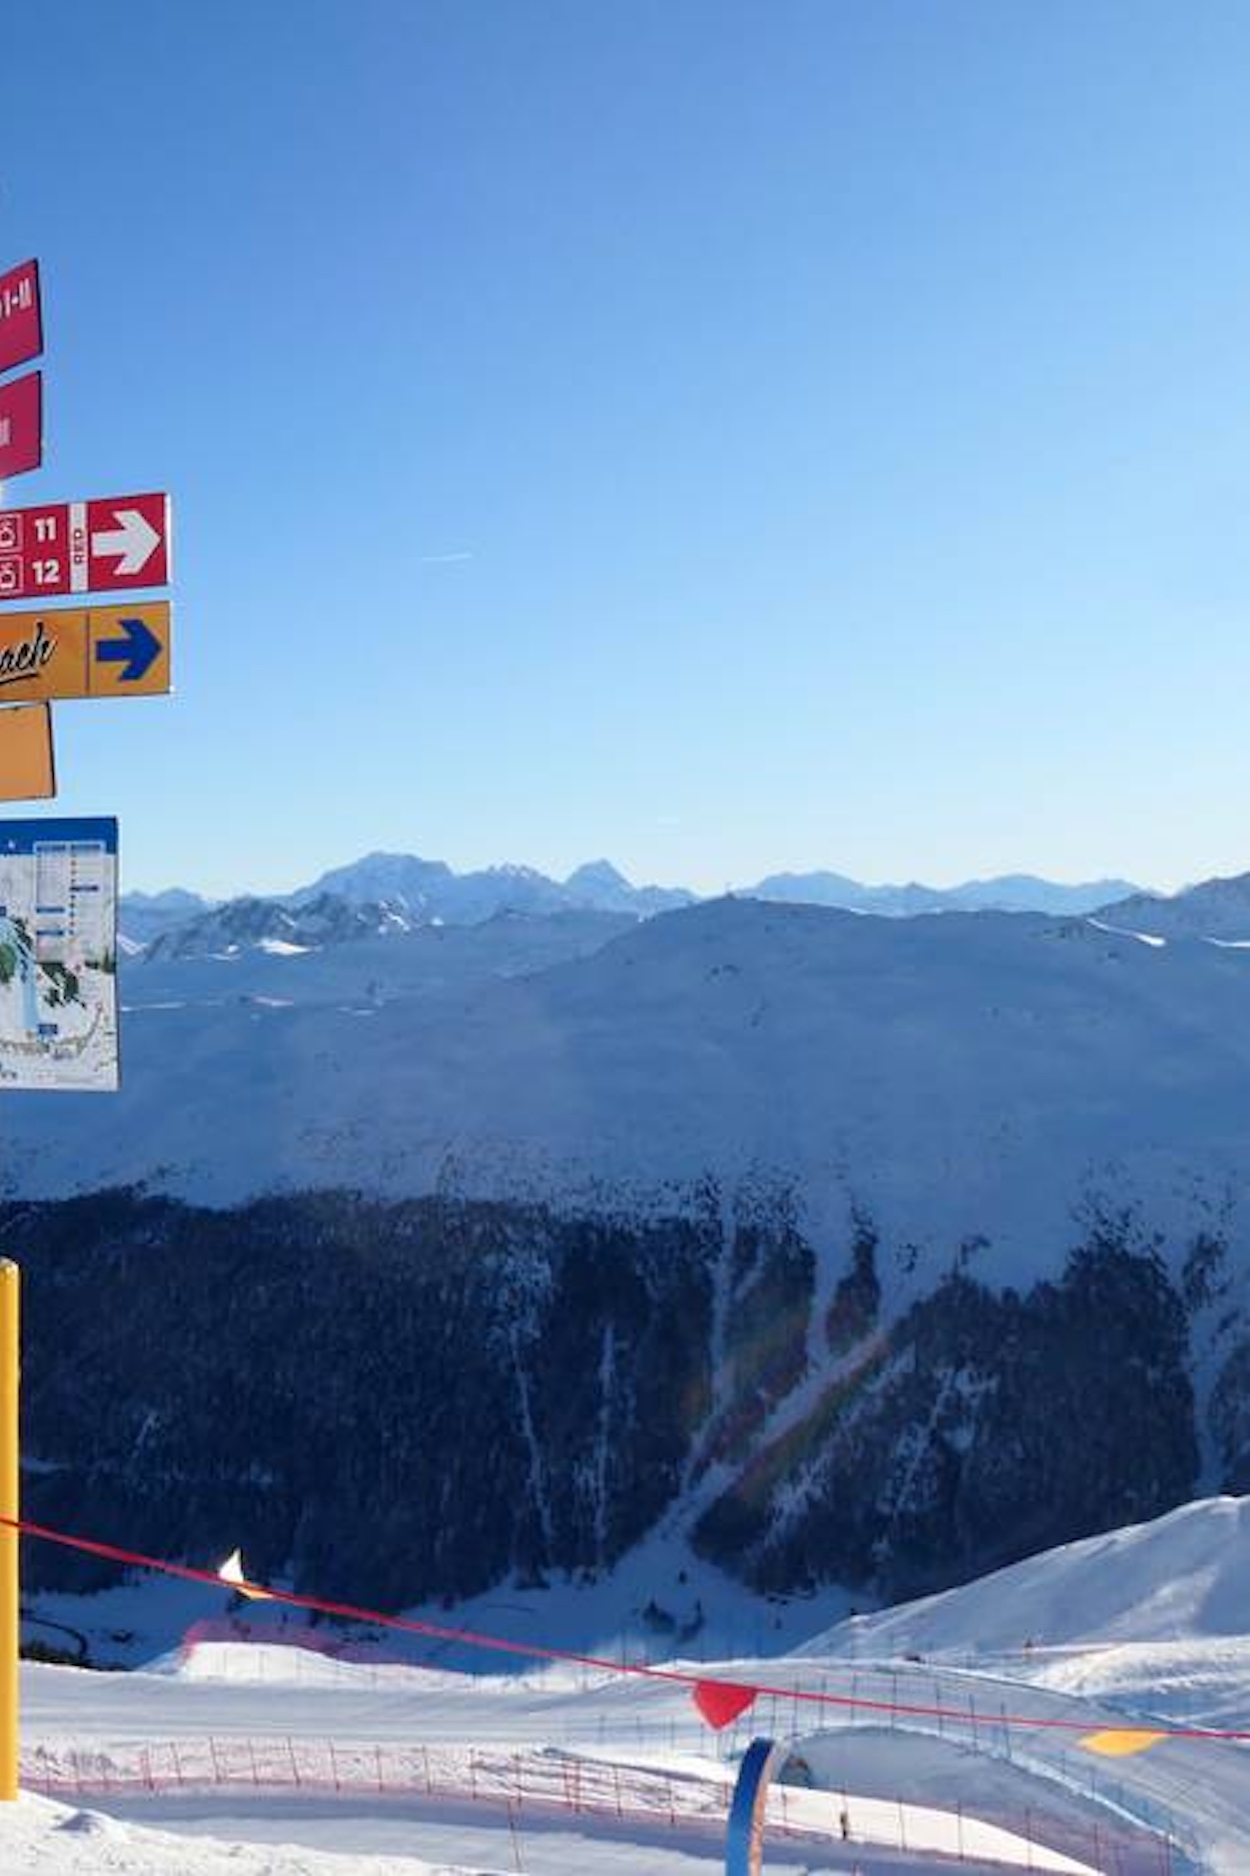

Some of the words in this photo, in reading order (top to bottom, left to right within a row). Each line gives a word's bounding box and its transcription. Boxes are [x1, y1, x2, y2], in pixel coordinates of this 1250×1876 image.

[4, 277, 32, 318] I-II
[35, 516, 57, 542] 11
[74, 528, 83, 565] RED
[32, 559, 60, 585] 12
